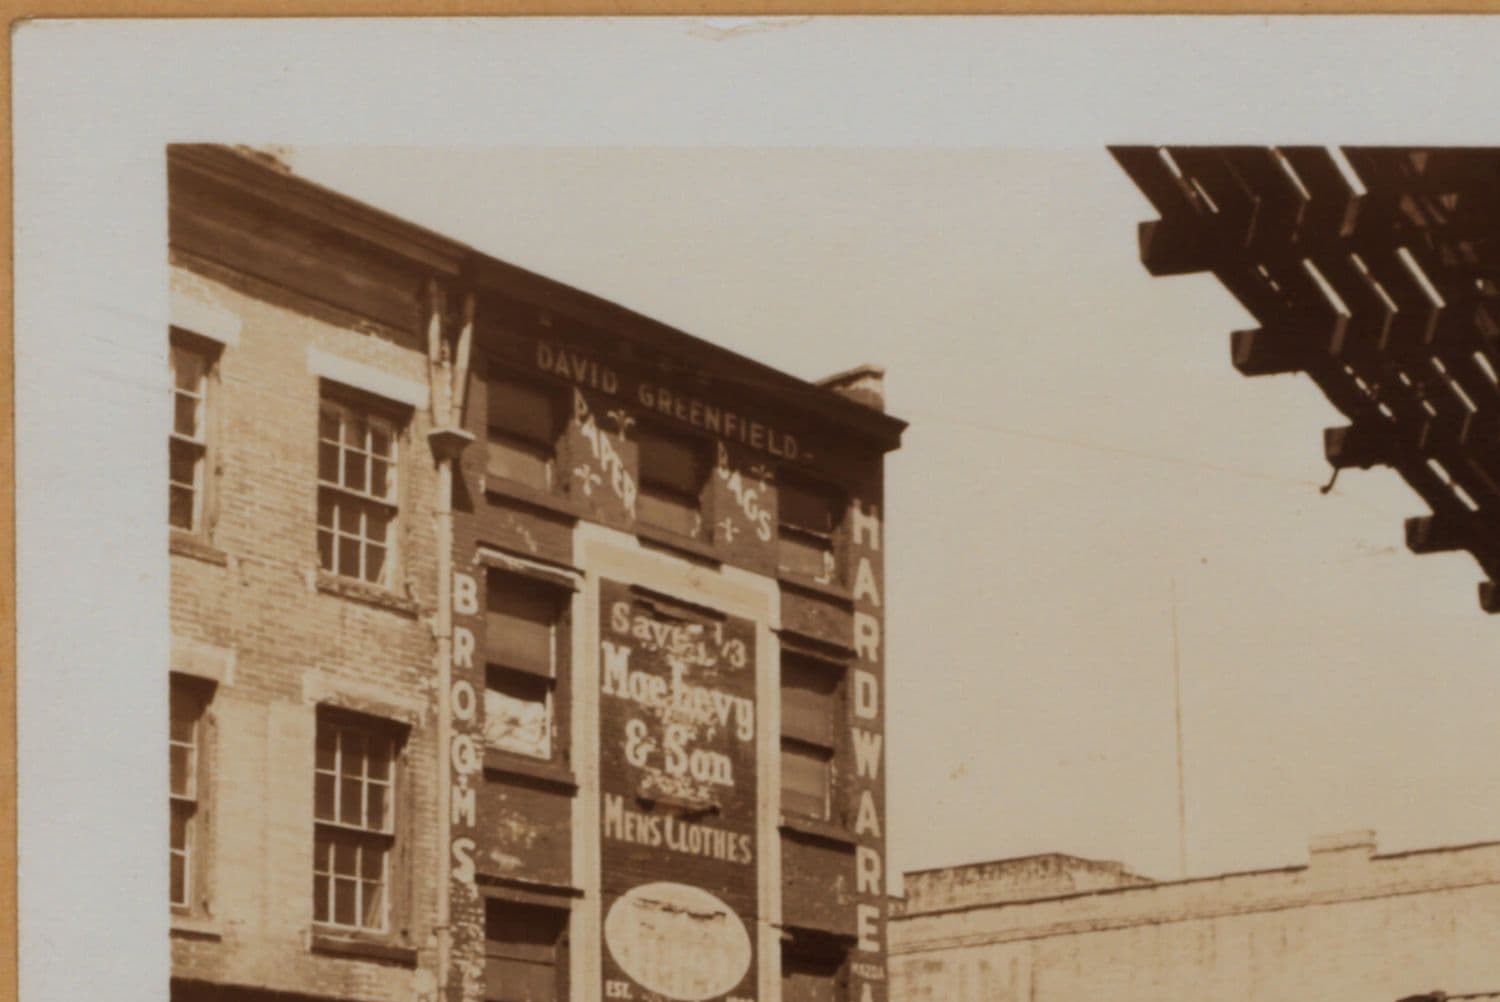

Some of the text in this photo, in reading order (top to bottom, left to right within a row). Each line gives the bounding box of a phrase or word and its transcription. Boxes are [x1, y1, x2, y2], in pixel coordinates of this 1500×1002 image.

[535, 346, 800, 460] DAVID GREENFIELD
[573, 387, 638, 521] PAPER
[601, 641, 667, 707] Moe
[624, 718, 657, 767] &
[663, 722, 735, 787] Son
[851, 499, 882, 953] HARDWARE
[663, 814, 752, 865] CLOTHES
